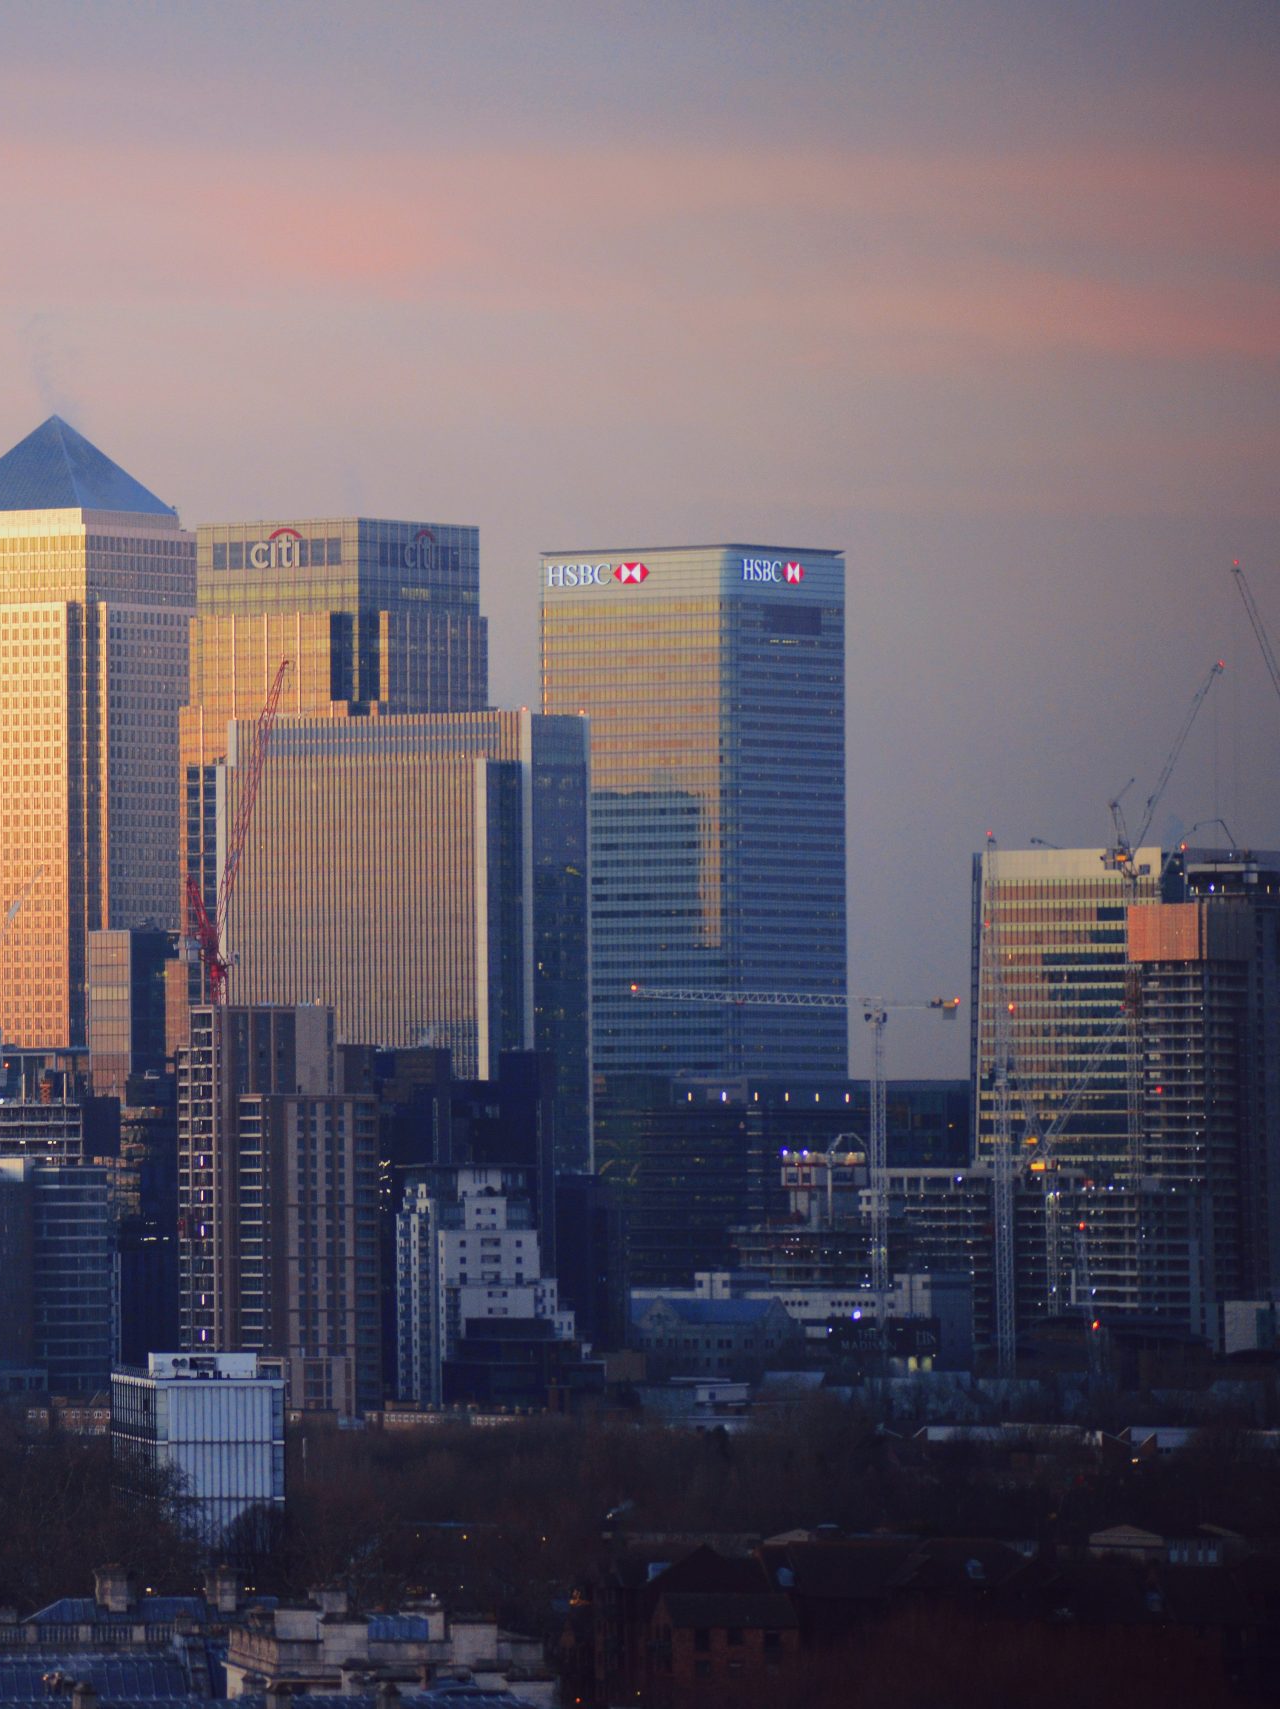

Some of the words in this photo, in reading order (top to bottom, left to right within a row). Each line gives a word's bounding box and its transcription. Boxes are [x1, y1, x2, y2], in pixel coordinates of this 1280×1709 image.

[250, 535, 300, 569] citi
[546, 561, 612, 588] HSBC
[742, 558, 782, 583] HSBC
